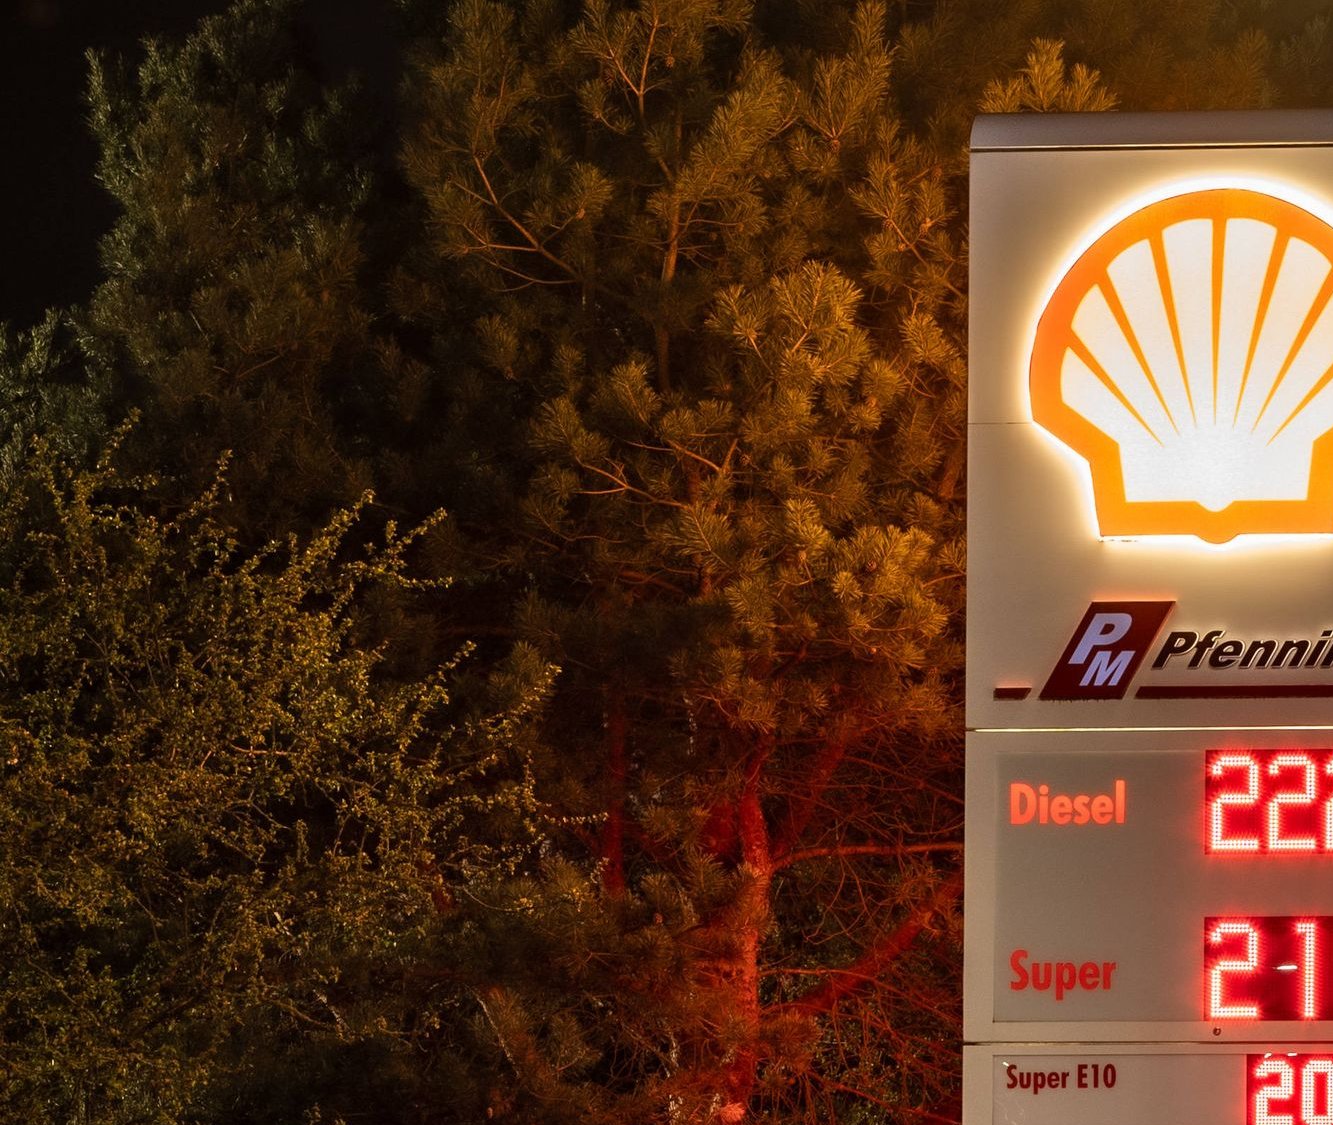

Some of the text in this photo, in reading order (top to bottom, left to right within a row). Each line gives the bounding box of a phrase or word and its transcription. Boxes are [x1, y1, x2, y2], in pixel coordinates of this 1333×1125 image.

[1068, 612, 1136, 687] PM
[1009, 779, 1126, 825] Diesel
[1009, 950, 1117, 1001] Super
[1006, 1064, 1117, 1095] Super E10
